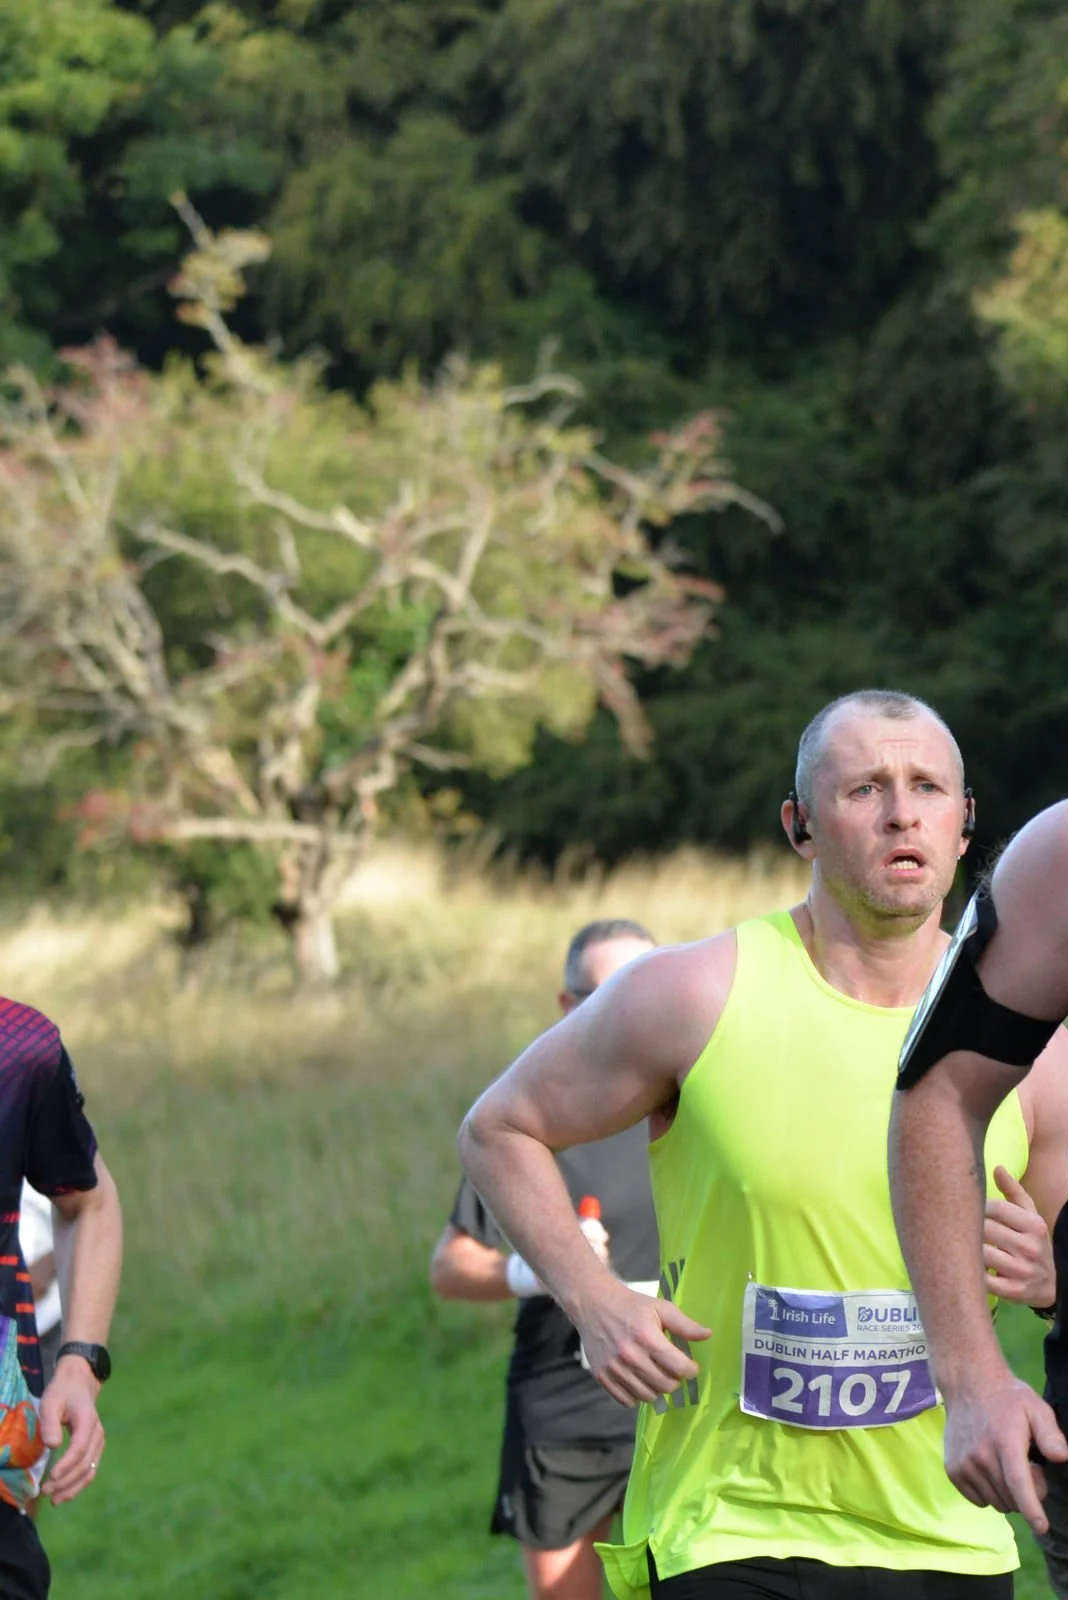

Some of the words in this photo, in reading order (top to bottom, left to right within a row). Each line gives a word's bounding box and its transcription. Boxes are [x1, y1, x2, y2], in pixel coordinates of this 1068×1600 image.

[782, 1308, 809, 1323] Irish
[811, 1311, 836, 1325] Life
[857, 1306, 918, 1323] DUBLI
[856, 1324, 879, 1332] RACE
[881, 1324, 911, 1332] SERIES
[754, 1338, 807, 1359] DUBLIN
[811, 1349, 850, 1361] HALF
[853, 1344, 926, 1360] MARATHO
[771, 1367, 912, 1417] 2107
